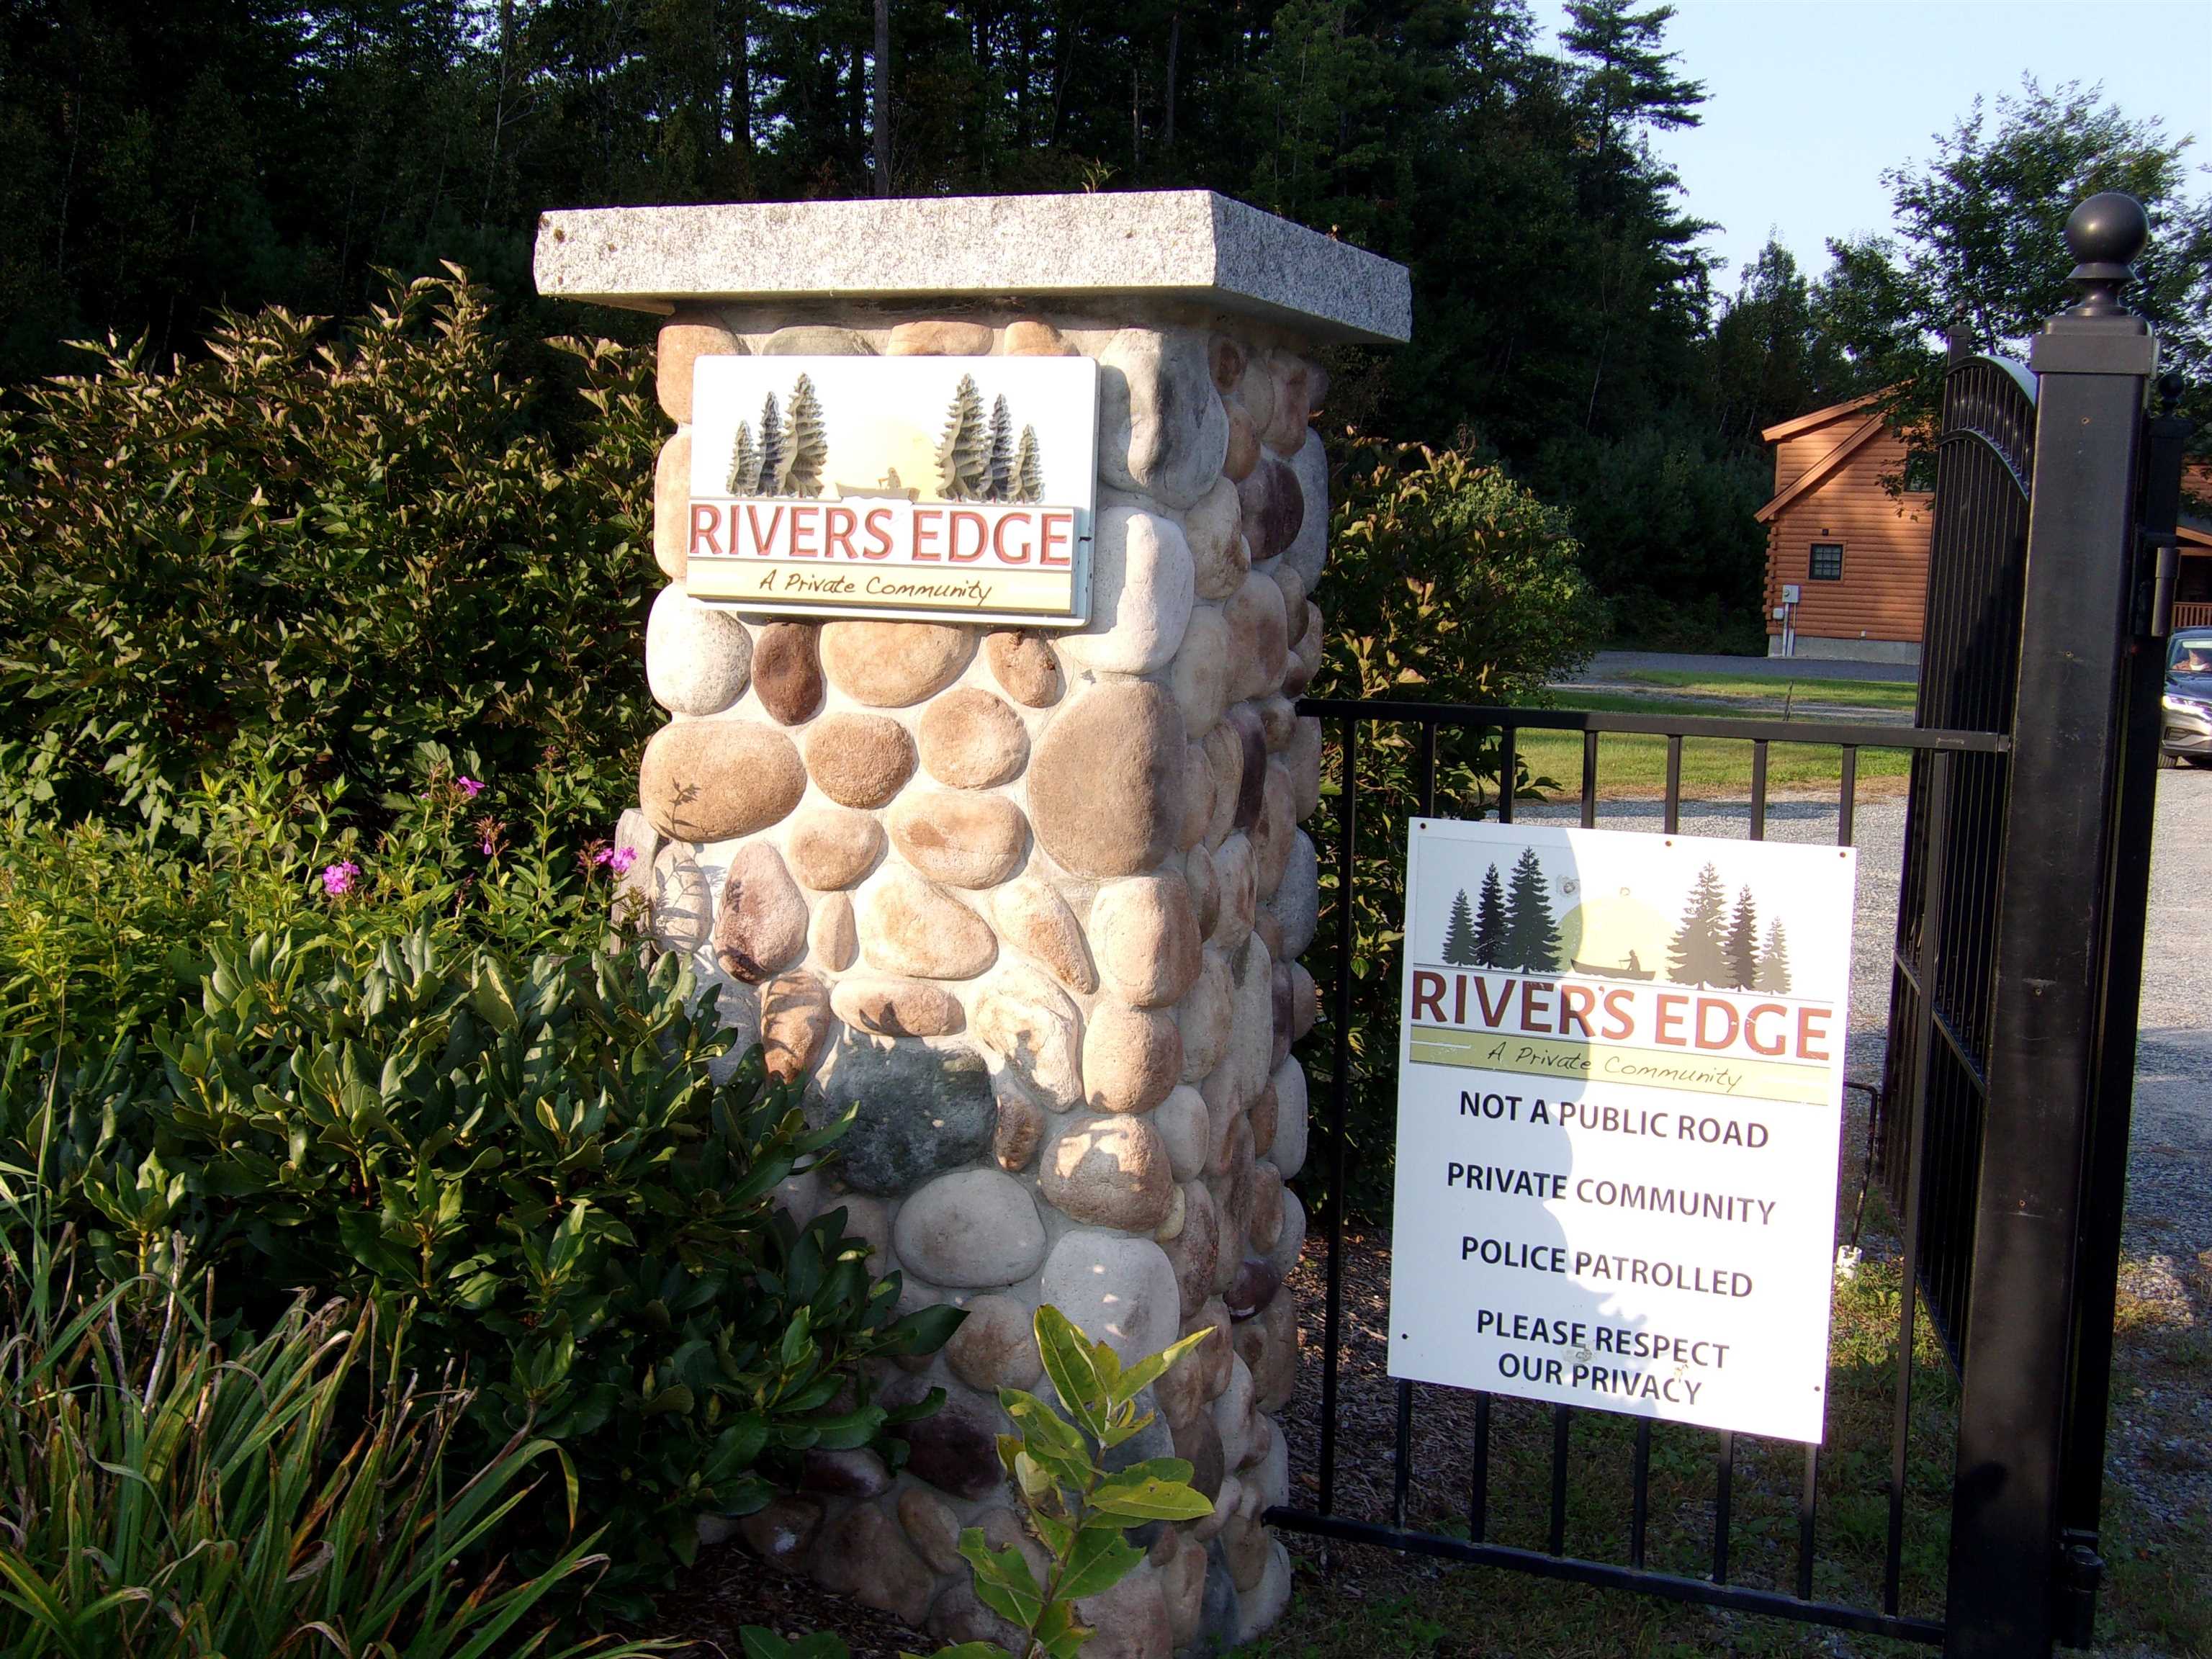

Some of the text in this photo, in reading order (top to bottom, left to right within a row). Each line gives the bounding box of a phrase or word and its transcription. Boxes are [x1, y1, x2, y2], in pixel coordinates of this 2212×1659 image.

[689, 504, 1072, 565] RIVERS EDGE
[760, 570, 992, 606] A Private Community
[1411, 971, 1833, 1061] RIVER'S EDGE
[1488, 1042, 1743, 1093] A Private Community
[1460, 1091, 1769, 1148] NOT A PUBLIC ROAD
[1447, 1162, 1776, 1226] PRIVATE COMMUNITY
[1462, 1236, 1753, 1298] POLICE PATROLLED
[1477, 1309, 1730, 1369] PLEASE RESPECT
[1498, 1353, 1702, 1405] OUR PRIVACY
